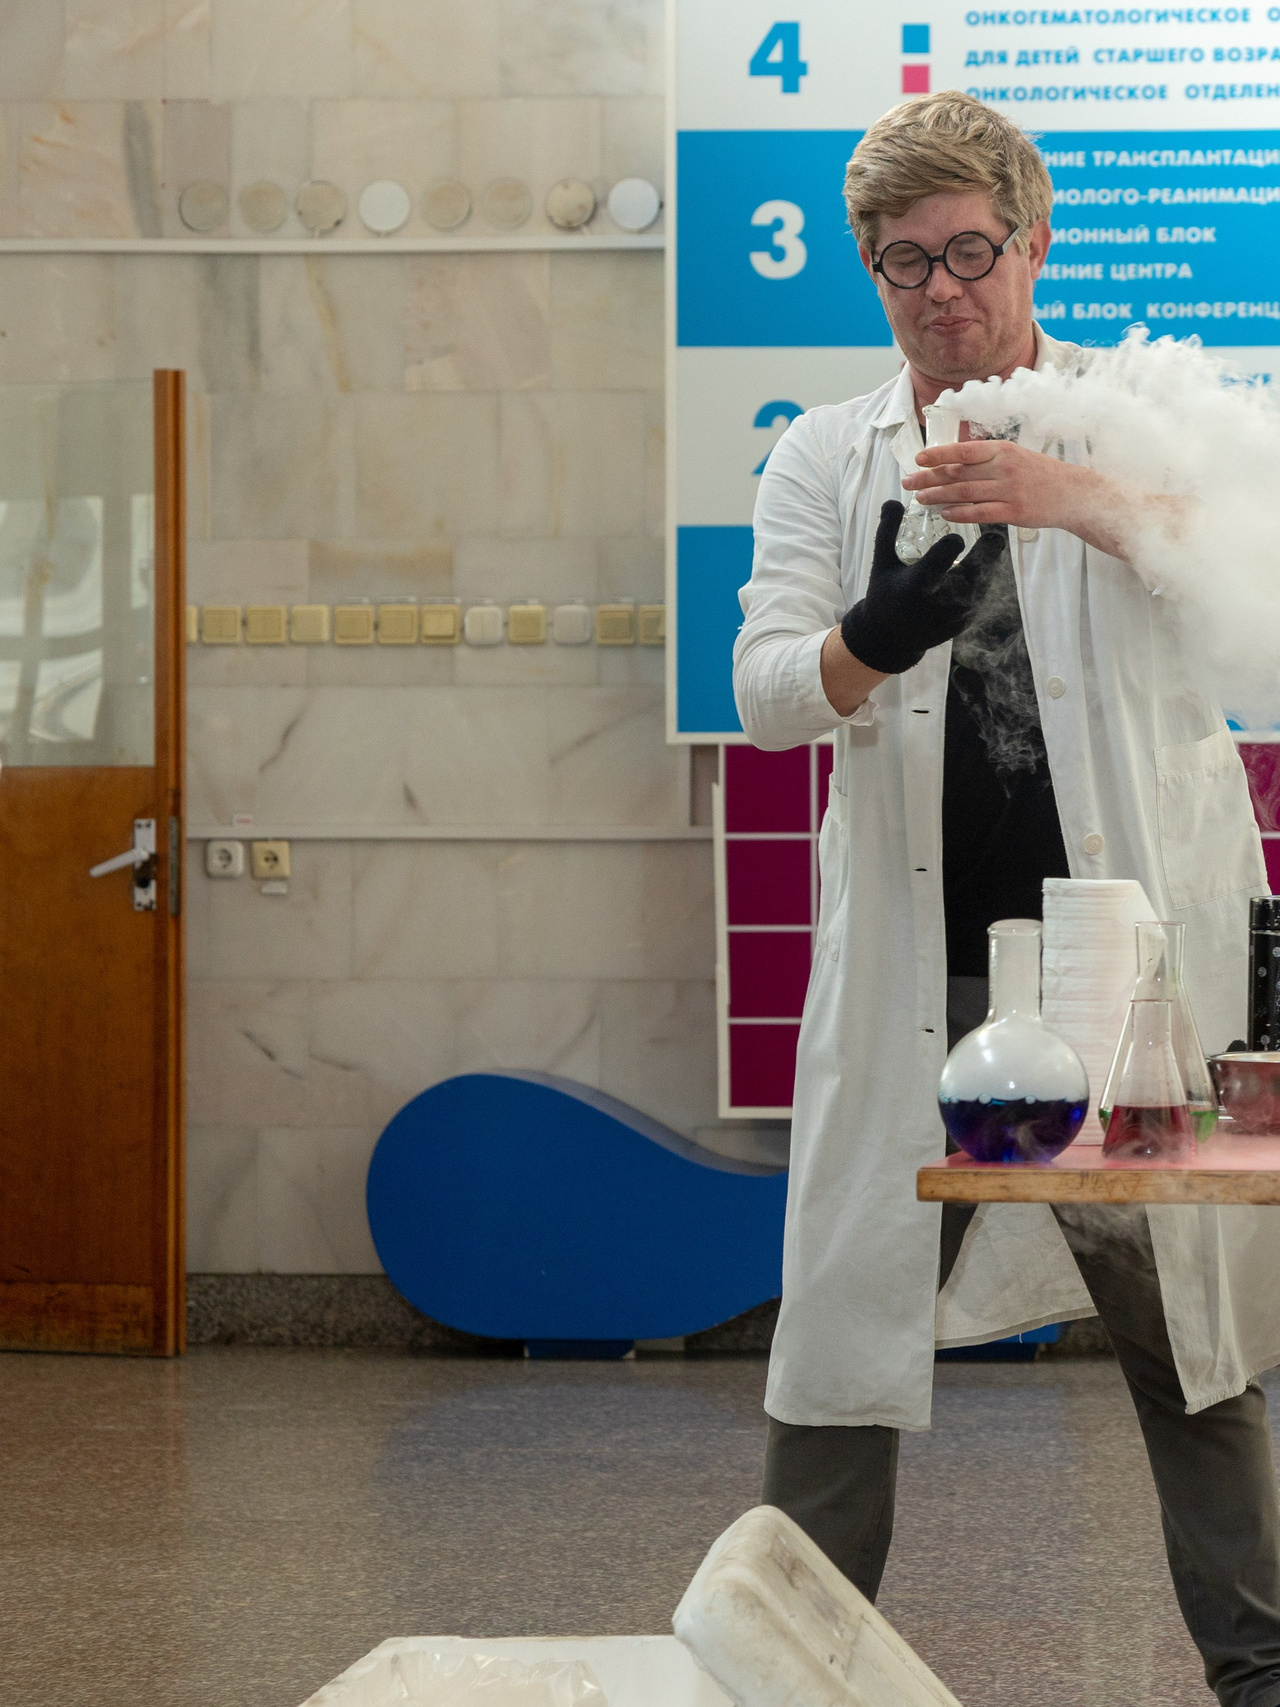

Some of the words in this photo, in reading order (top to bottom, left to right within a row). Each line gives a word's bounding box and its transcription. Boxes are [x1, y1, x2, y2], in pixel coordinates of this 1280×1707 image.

[964, 7, 1251, 27] ОНКОГЕМАТОЛОГИЧЕСКОЕ
[748, 20, 809, 95] 4
[964, 49, 1009, 68] ДЛЯ
[1015, 45, 1081, 67] ДЕТЕЙ
[1092, 47, 1205, 64] СТАРШЕГО
[966, 84, 1168, 103] ОНКОЛОГИЧЕСКОЕ
[749, 199, 808, 280] 3
[1050, 224, 1150, 244] ИОННЫЙ
[1156, 227, 1216, 244] БЛОК
[1110, 262, 1193, 281] ЦЕНТРА
[1072, 302, 1133, 320] БЛОК
